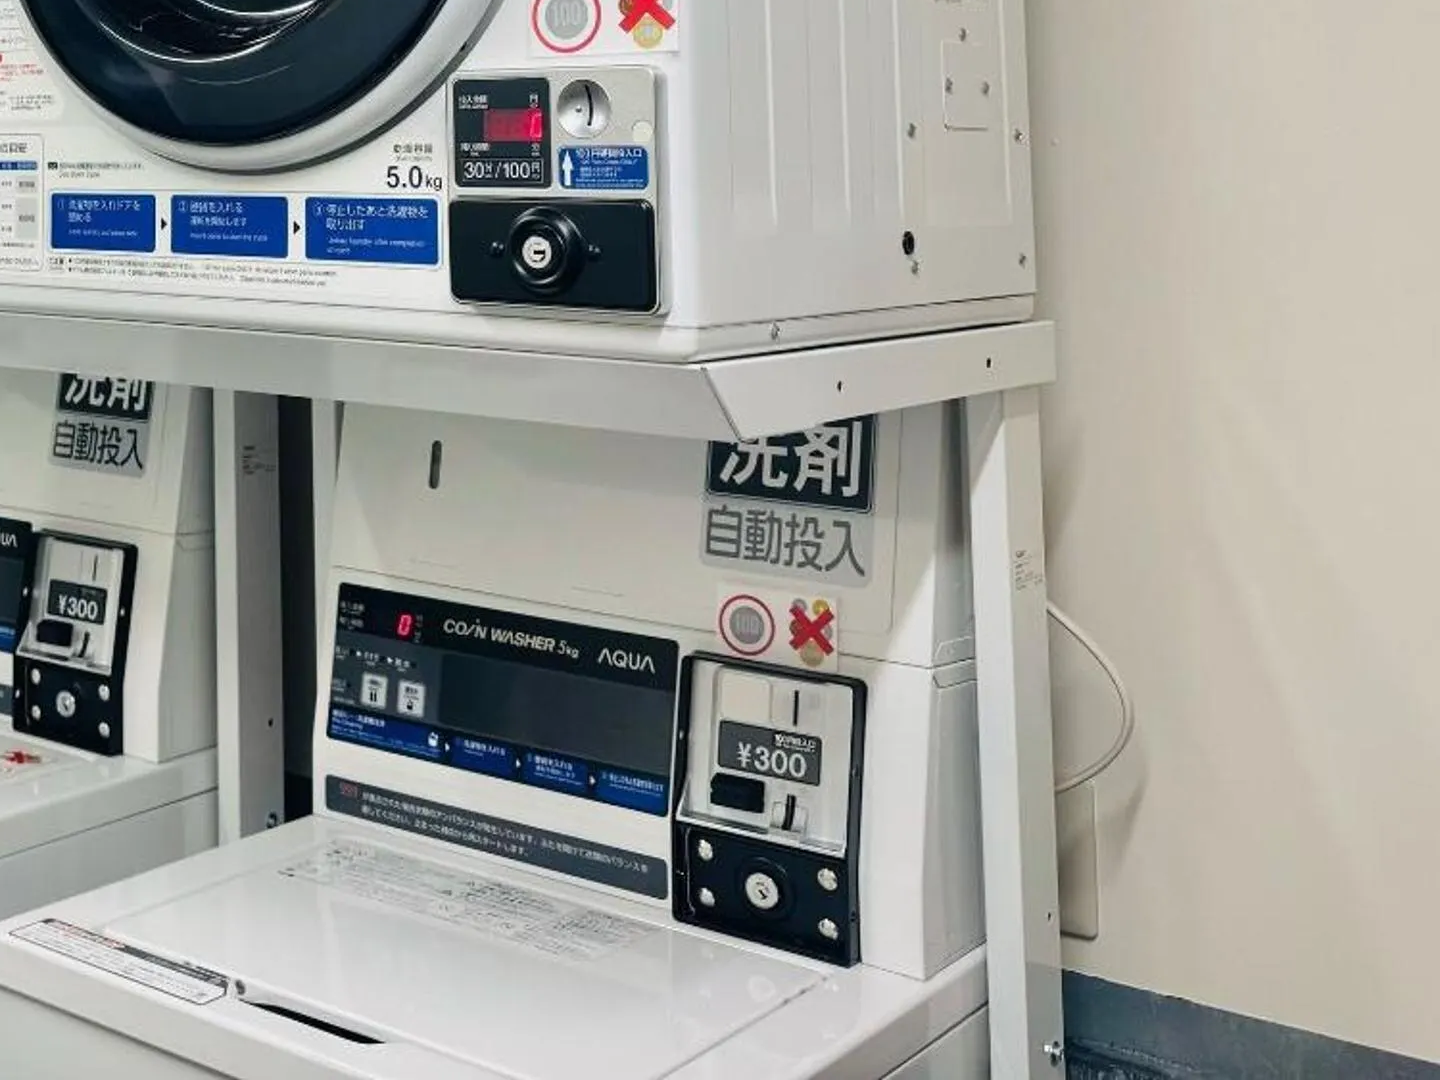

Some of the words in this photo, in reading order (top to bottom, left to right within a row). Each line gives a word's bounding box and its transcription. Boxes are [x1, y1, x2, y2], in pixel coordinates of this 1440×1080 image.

[53, 420, 143, 469] 自動投入
[706, 505, 865, 577] 自動投入
[58, 595, 98, 620] ¥300
[397, 614, 412, 636] 0
[490, 628, 556, 653] WASHER
[597, 647, 656, 674] AQUA
[736, 741, 807, 778] ¥300
